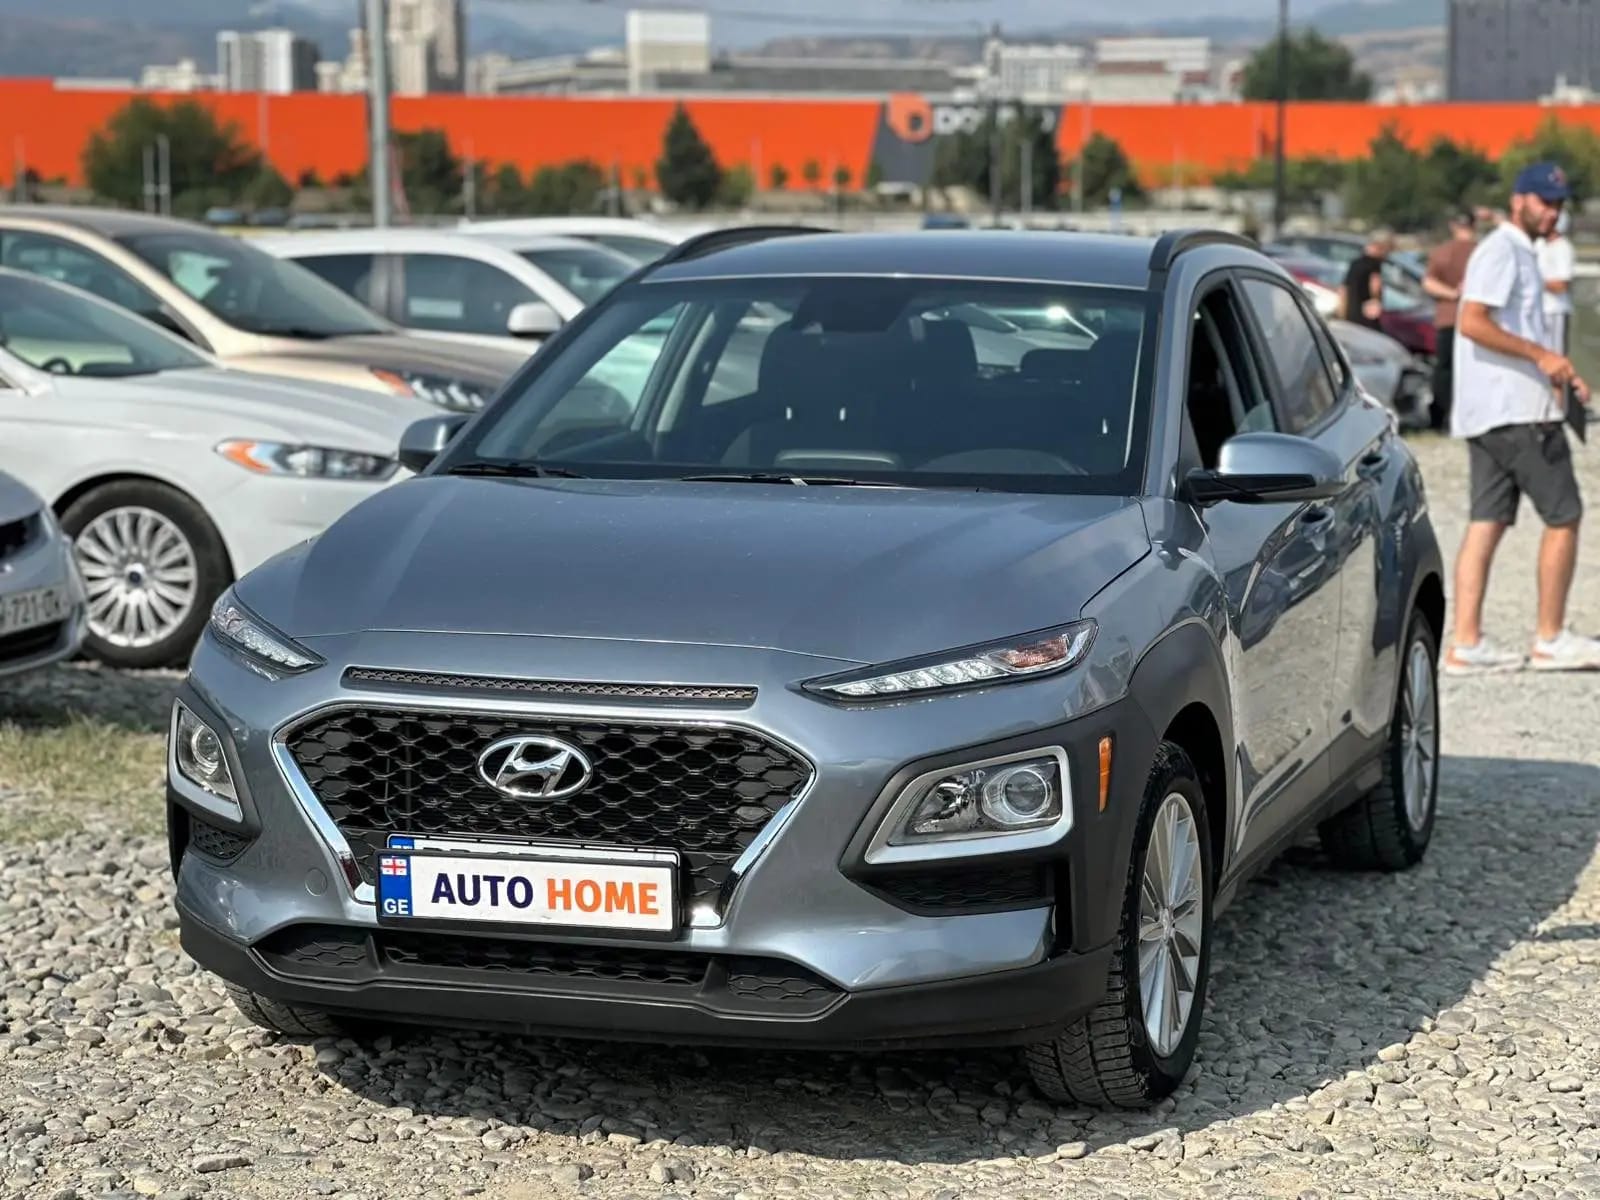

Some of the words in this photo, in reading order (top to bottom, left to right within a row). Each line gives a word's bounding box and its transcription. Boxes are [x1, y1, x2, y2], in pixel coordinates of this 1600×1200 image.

[384, 898, 409, 914] GE
[432, 873, 533, 908] AUTO
[547, 879, 658, 915] HOME
